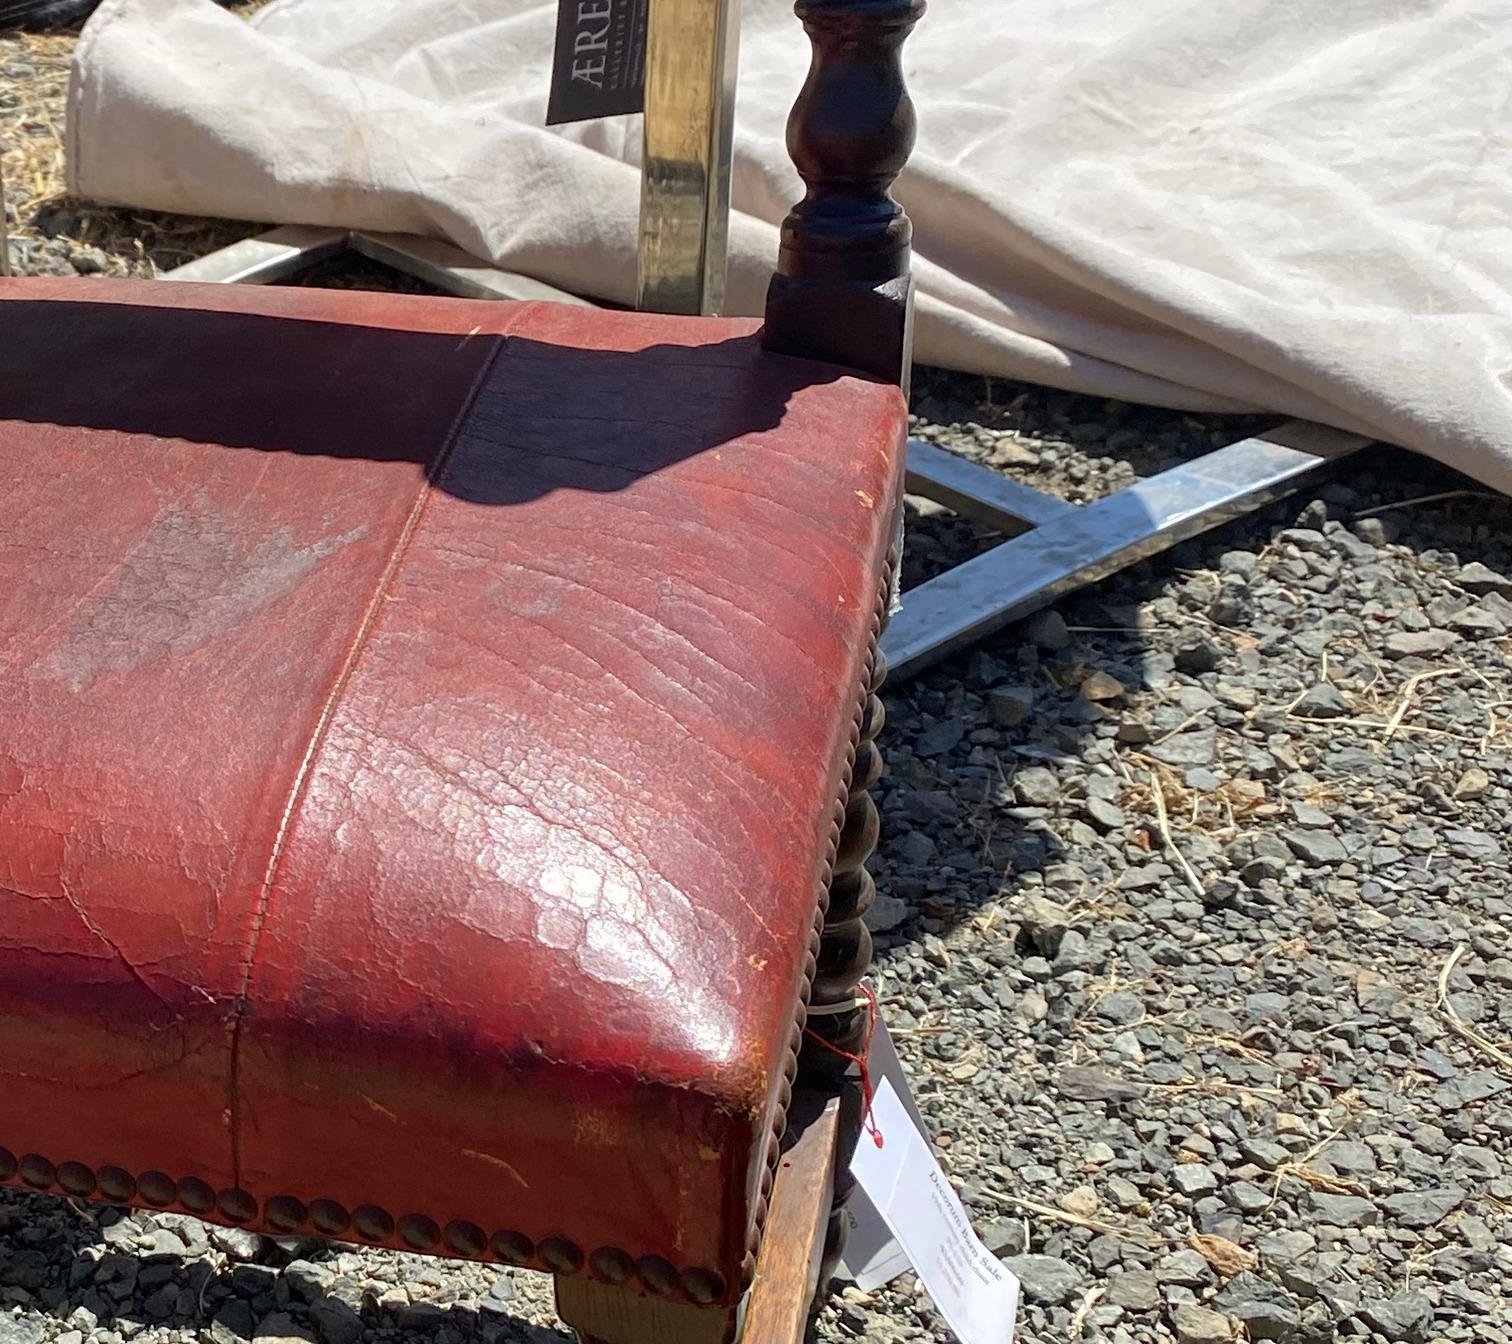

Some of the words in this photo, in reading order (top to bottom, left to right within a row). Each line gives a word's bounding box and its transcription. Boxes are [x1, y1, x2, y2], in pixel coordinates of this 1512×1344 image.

[928, 1170, 963, 1229] Decorum
[961, 1227, 979, 1258] Barn
[980, 1256, 1003, 1282] Sale
